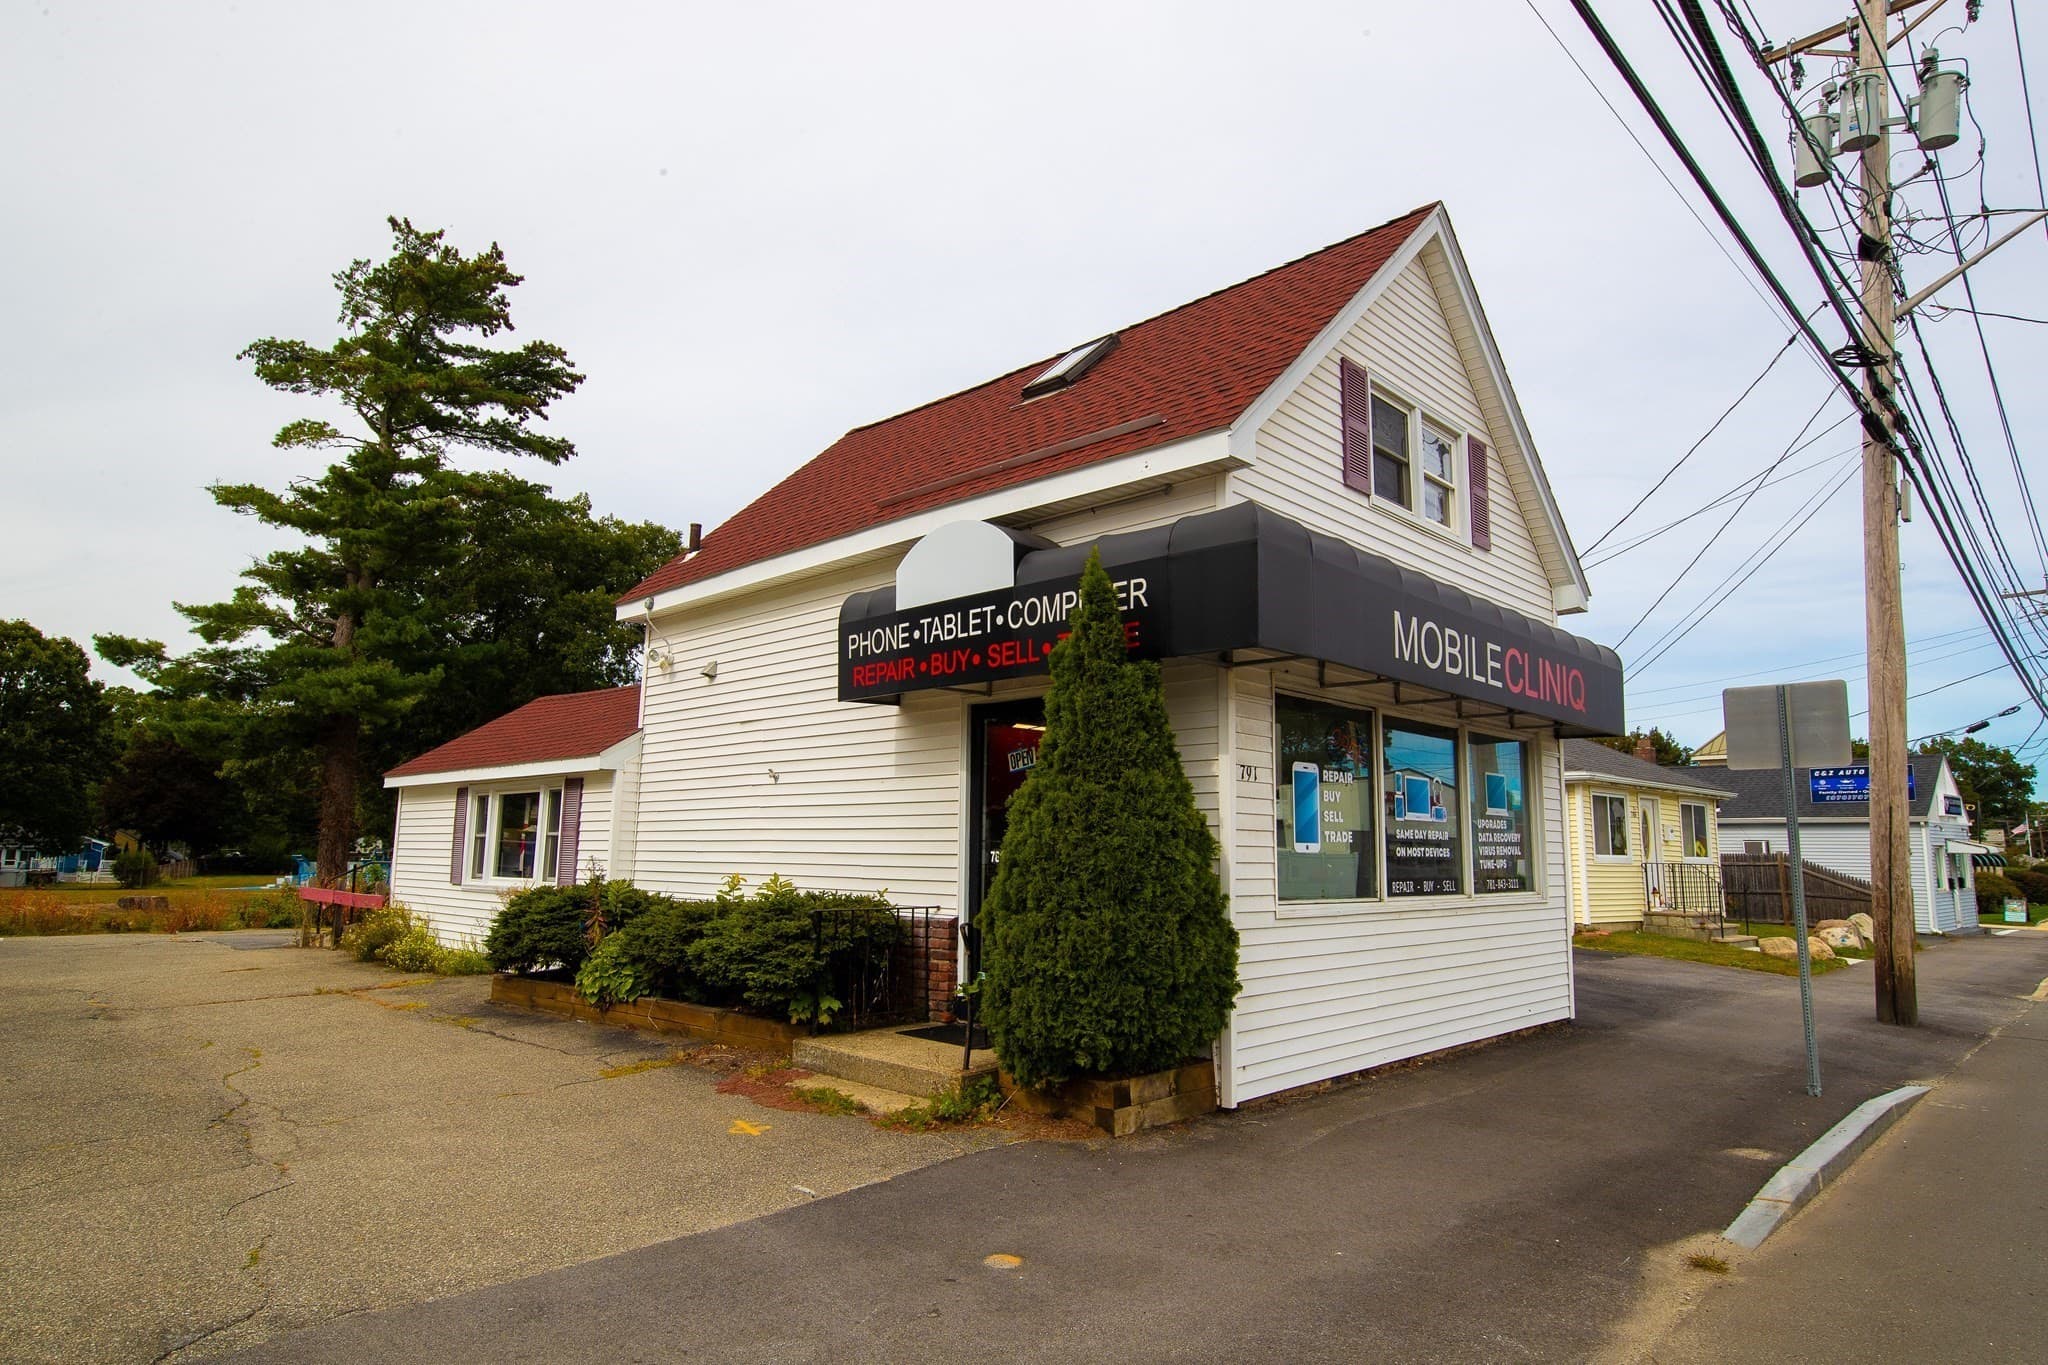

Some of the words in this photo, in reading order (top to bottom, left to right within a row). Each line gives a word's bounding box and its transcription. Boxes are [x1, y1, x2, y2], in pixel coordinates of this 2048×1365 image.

[848, 622, 910, 659] PHONE
[920, 605, 996, 644] TABLET
[1007, 577, 1148, 629] COMPER
[853, 657, 916, 688] REPAIR
[930, 648, 970, 676] BUY
[988, 639, 1040, 668] SELL
[1010, 749, 1034, 770] OPEN
[1240, 764, 1257, 782] 791
[1322, 769, 1353, 784] REPAIR
[1323, 790, 1341, 802] BUY
[1323, 810, 1344, 823] SELL
[1478, 818, 1507, 830] UPGRADES
[1324, 830, 1353, 843] TRADE
[1396, 829, 1414, 840] SAME
[1414, 830, 1428, 840] DAY
[1428, 830, 1449, 840] REPAIR
[1478, 832, 1494, 842] DATA
[1494, 832, 1521, 842] RECOVERY
[1396, 846, 1406, 857] ON
[1406, 847, 1424, 857] MOST
[1425, 848, 1450, 858] DEVICES
[1478, 846, 1496, 856] VIRUS
[1496, 846, 1522, 856] REMOVAL
[1480, 859, 1508, 870] TUNE-UPS
[1392, 881, 1414, 893] REPAIR
[1423, 880, 1435, 892] BUY
[1442, 880, 1457, 892] SELL
